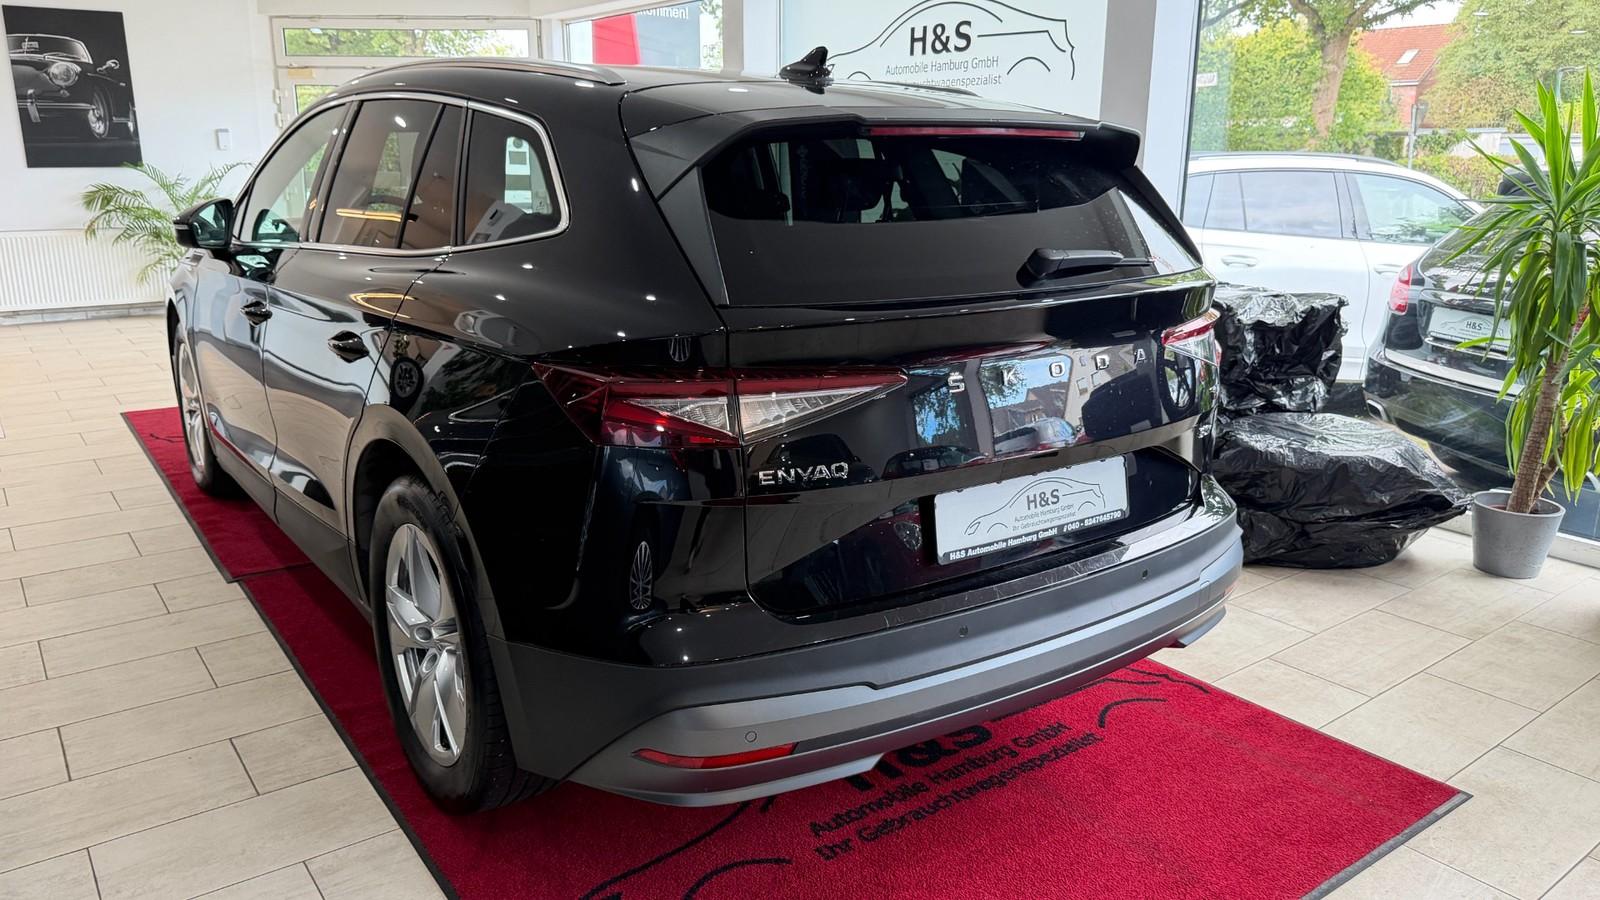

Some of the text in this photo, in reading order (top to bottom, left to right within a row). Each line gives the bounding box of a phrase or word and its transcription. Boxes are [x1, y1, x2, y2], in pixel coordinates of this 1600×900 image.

[909, 20, 972, 56] H&S
[885, 55, 999, 76] Automobile Hamburg GmbH
[1465, 321, 1483, 331] H&S
[758, 462, 849, 486] ENYAQ
[1026, 488, 1060, 511] H&S
[949, 550, 966, 561] H&S
[967, 541, 1007, 557] Automobile
[1007, 533, 1037, 547] Hamburg
[1038, 527, 1058, 539] GmbH
[810, 721, 1072, 836] Automobile Hamburg GmbH
[814, 731, 1104, 861] Ihr Gebrauchtwagenspezialist
